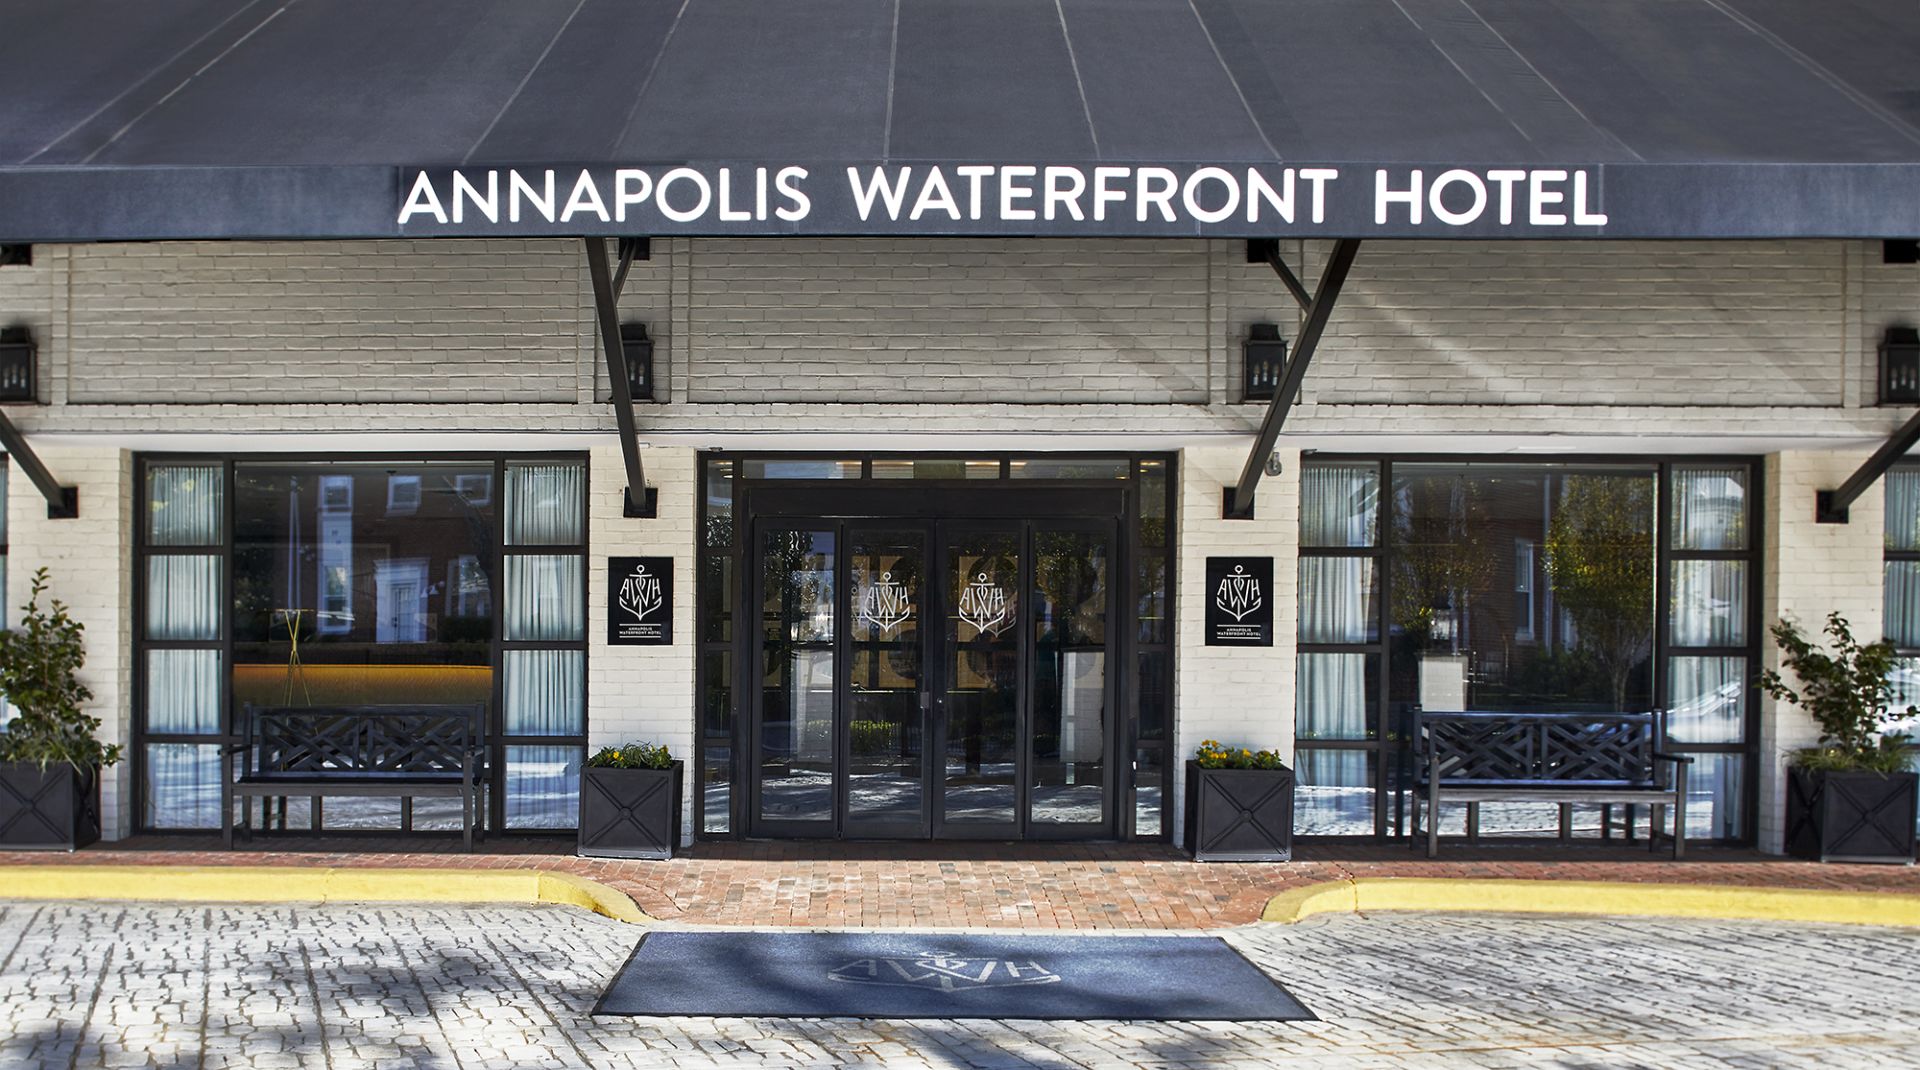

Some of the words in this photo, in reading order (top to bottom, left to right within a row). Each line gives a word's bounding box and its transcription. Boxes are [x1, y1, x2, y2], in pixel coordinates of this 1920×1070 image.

[397, 165, 811, 224] ANNAPOLIS
[846, 165, 1339, 224] WATERFRONT
[1374, 168, 1609, 227] HOTEL
